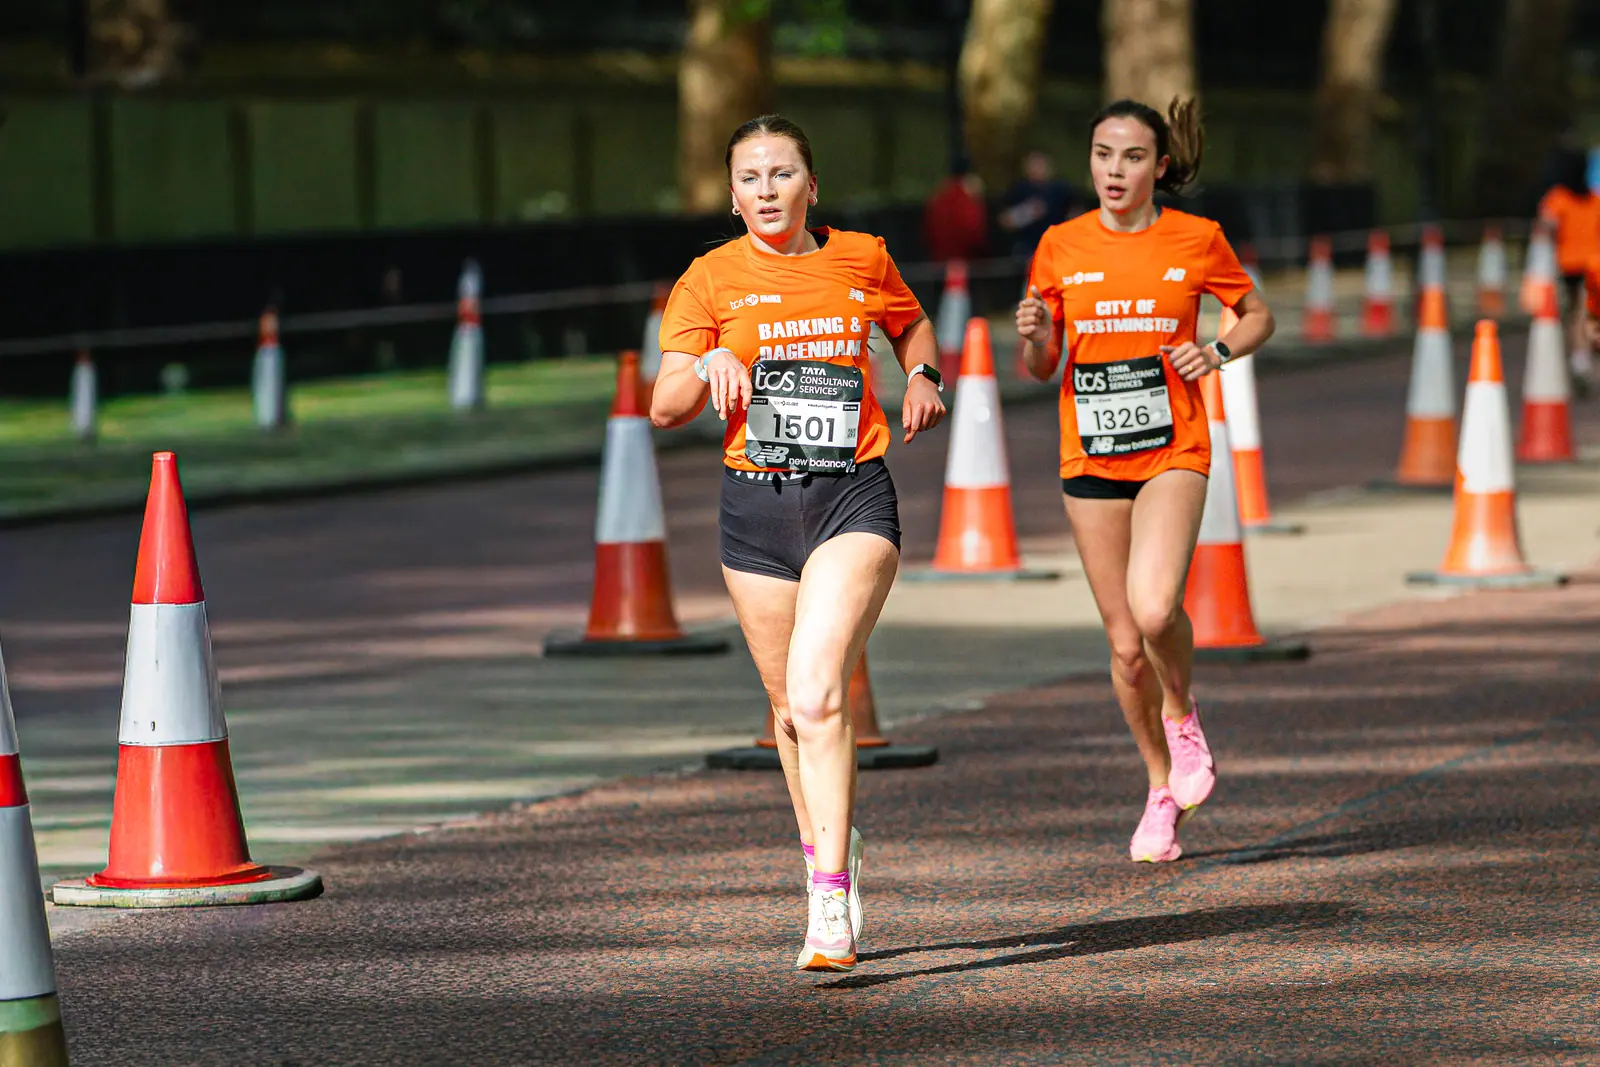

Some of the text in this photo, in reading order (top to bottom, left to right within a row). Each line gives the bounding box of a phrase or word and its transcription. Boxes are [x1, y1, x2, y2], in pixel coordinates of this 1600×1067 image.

[1095, 299, 1156, 316] CITY OF
[758, 316, 862, 340] BARKING &
[759, 340, 862, 360] DAGENHAM
[801, 366, 827, 376] TATA
[1106, 364, 1131, 375] TATA
[1107, 368, 1160, 383] CONSULTANCY
[754, 366, 796, 392] tcs
[799, 375, 859, 388] CONSULTANCY
[1074, 367, 1107, 392] tcs
[1108, 379, 1144, 391] SERVICES
[799, 385, 838, 396] SERVICES
[1093, 405, 1150, 431] 1326
[773, 413, 835, 443] 1501
[788, 457, 847, 469] new balance
